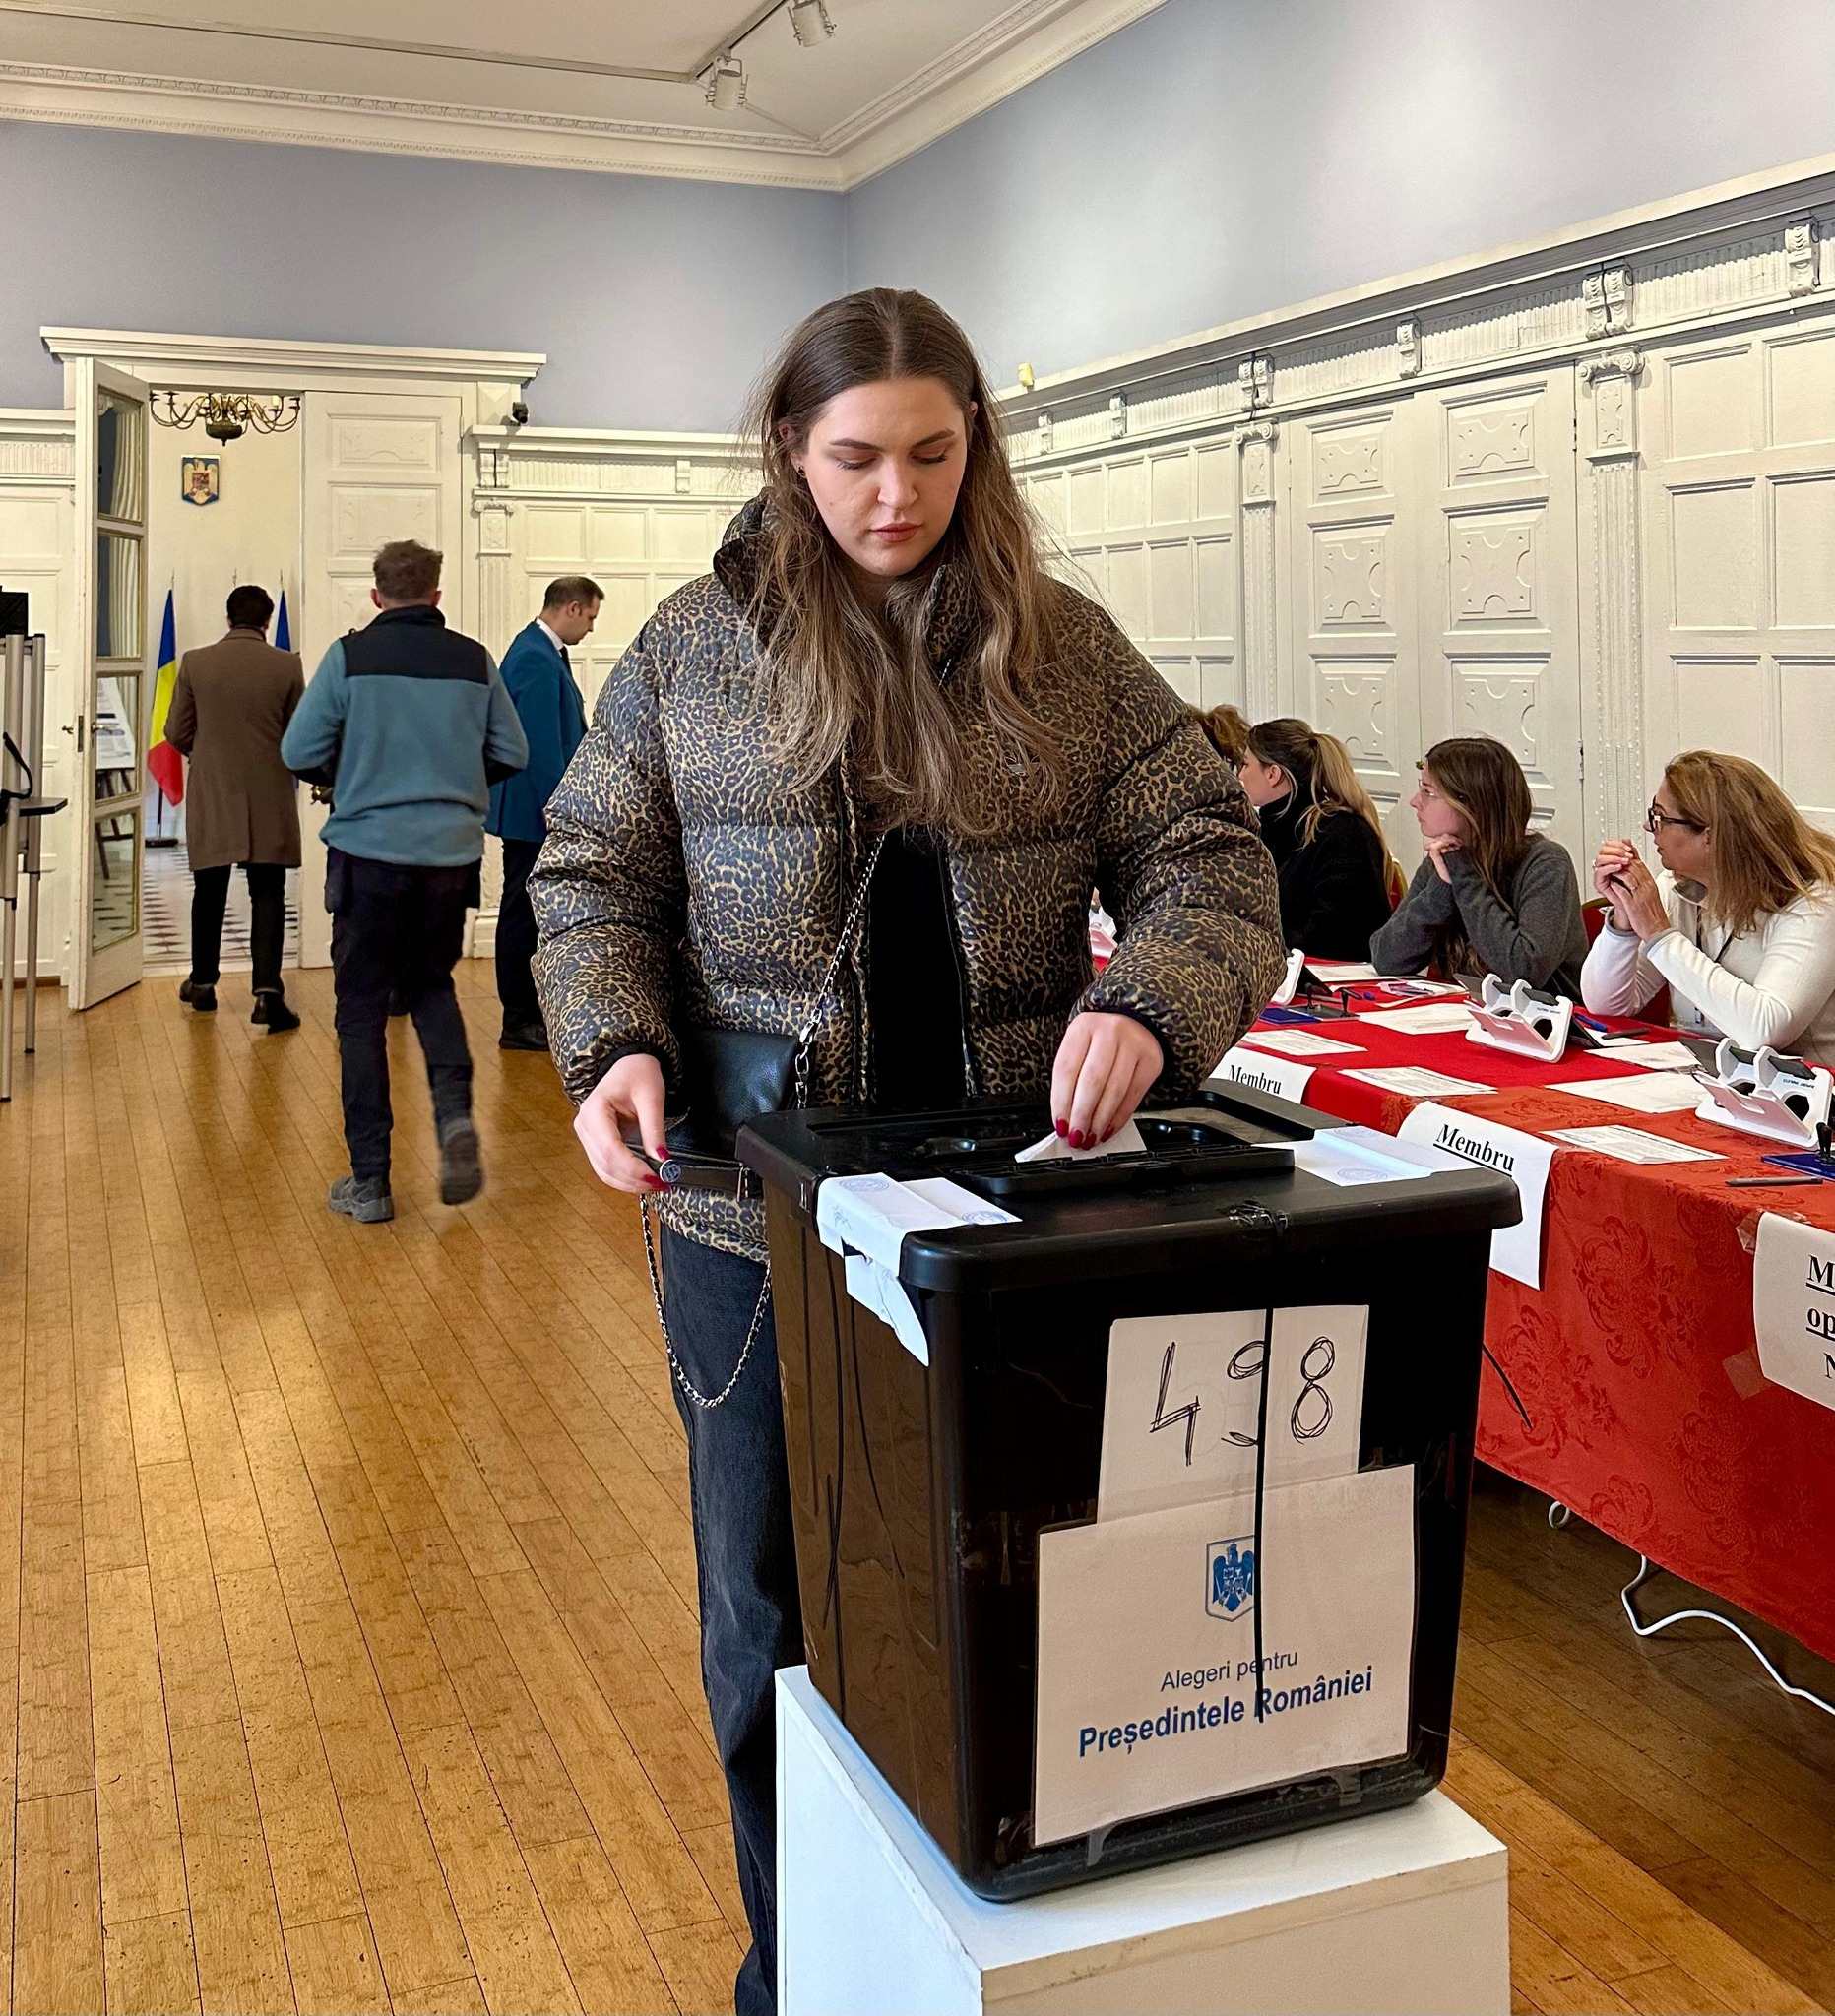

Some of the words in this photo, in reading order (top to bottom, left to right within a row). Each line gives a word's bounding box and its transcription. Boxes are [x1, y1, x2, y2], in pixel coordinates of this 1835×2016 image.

[1228, 1063, 1282, 1095] Membru
[1435, 1123, 1515, 1172] Membru
[1160, 1660, 1231, 1692] Alegeri
[1236, 1651, 1298, 1681] pentru
[1079, 1695, 1245, 1758] Președintele
[1253, 1665, 1372, 1719] României
